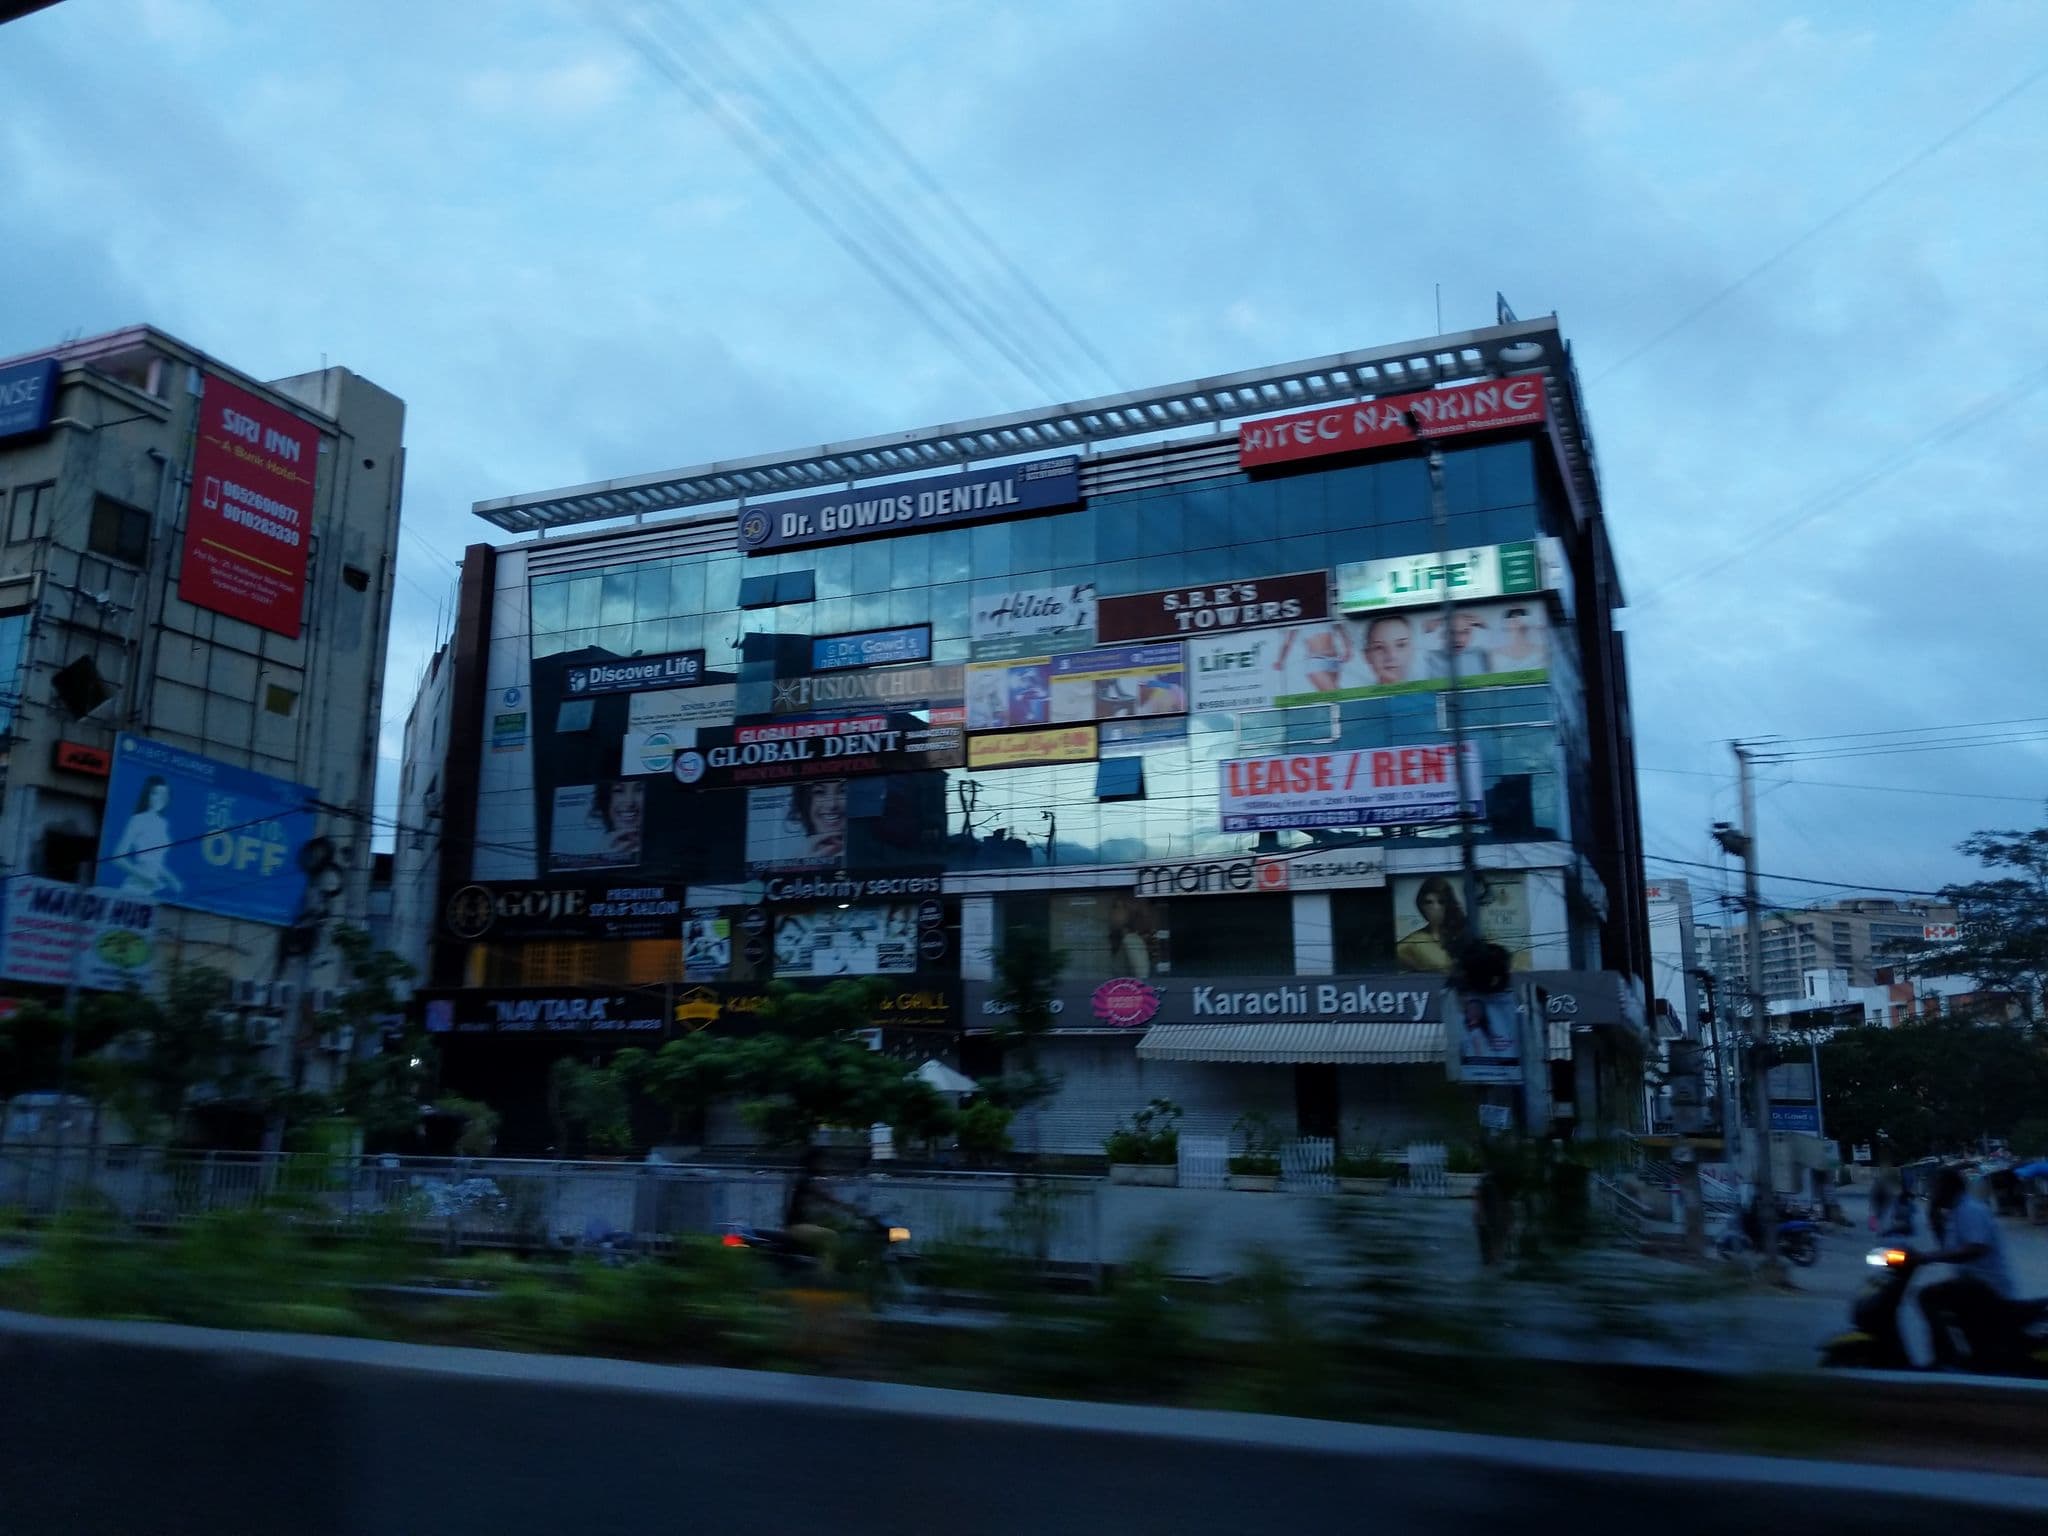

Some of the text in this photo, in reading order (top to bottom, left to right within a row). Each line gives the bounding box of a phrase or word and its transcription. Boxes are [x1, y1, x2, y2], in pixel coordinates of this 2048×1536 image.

[1353, 381, 1538, 435] NANKING
[264, 427, 301, 463] INN
[781, 479, 1020, 538] Dr. GOWDS DENTAL
[1174, 600, 1303, 631] TOWERS
[588, 656, 698, 684] Discover Life
[799, 673, 875, 705] FUSION
[707, 738, 816, 768] GLOBAL
[821, 731, 902, 758] DENT
[1228, 754, 1334, 798] LEASE
[1344, 753, 1361, 790] /
[201, 833, 288, 876] OFF
[1324, 861, 1384, 878] SALON
[495, 889, 588, 920] GOJE
[766, 874, 941, 902] Celebrity secrets
[1192, 983, 1431, 1022] Karachi Bakery
